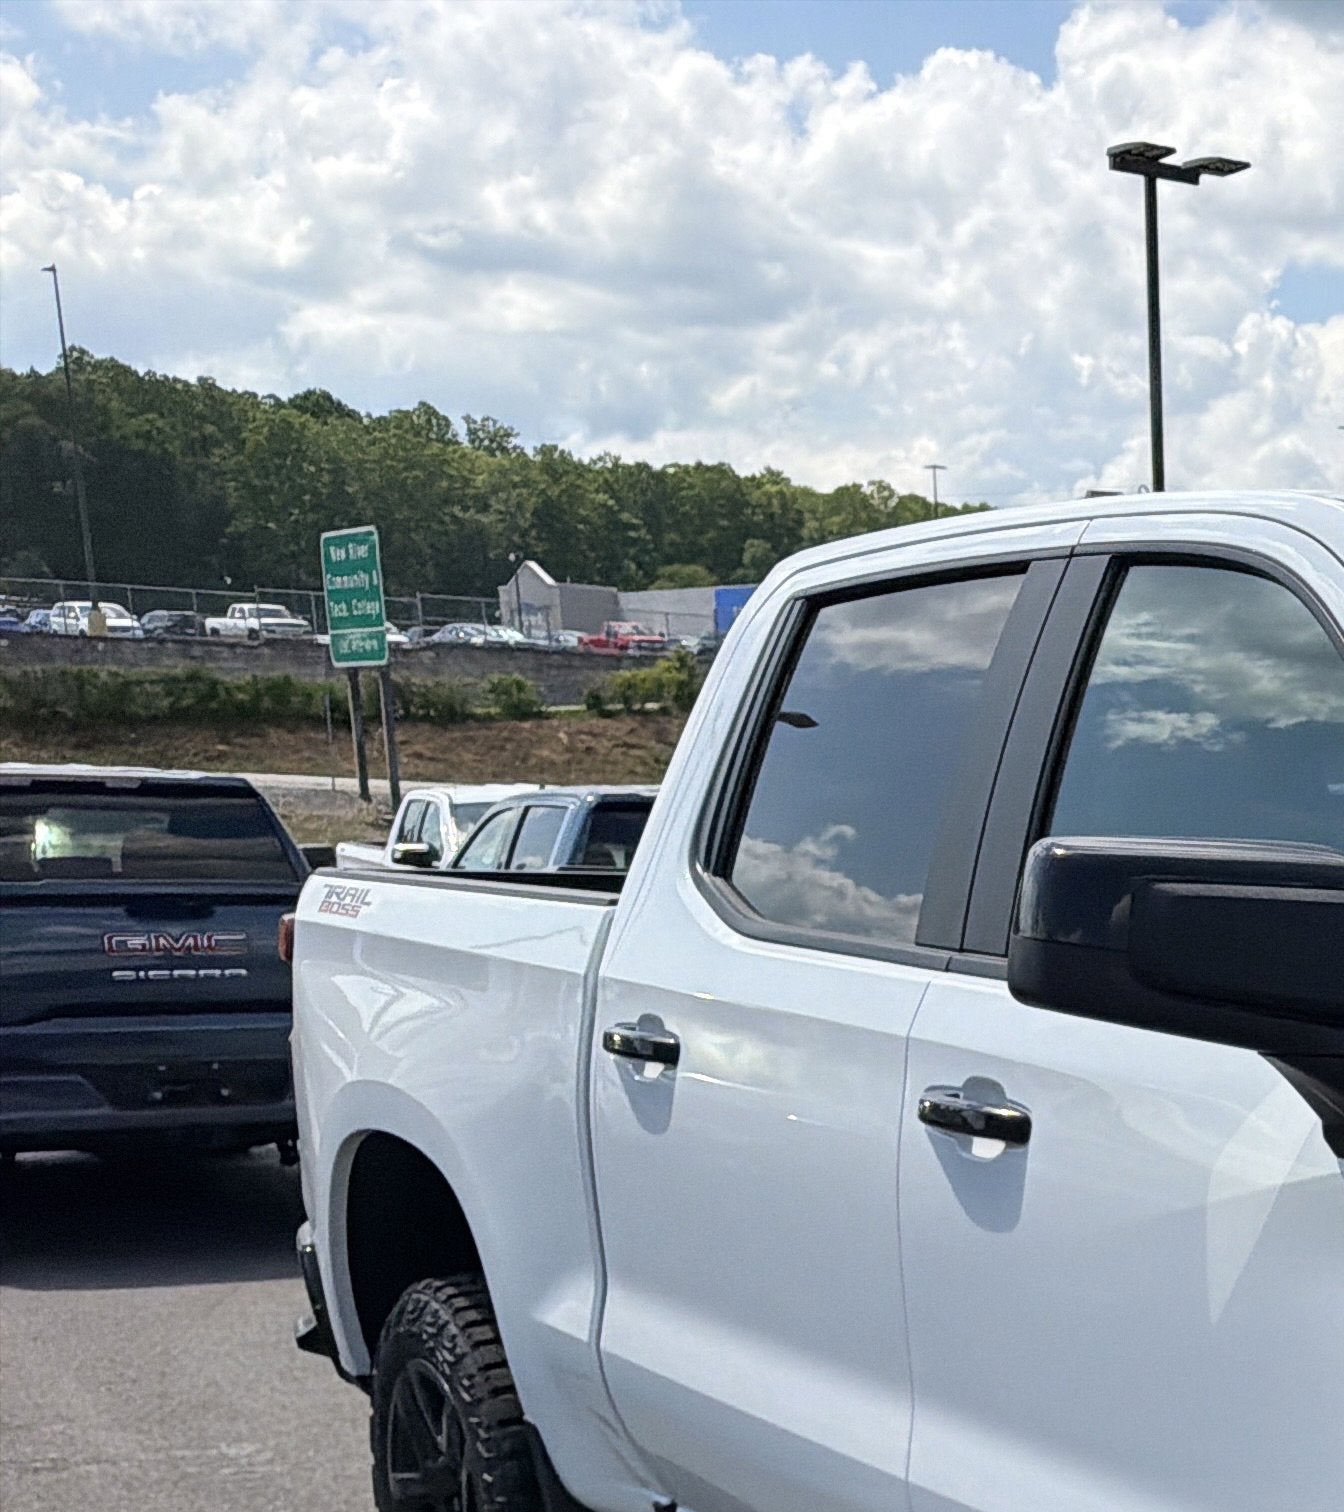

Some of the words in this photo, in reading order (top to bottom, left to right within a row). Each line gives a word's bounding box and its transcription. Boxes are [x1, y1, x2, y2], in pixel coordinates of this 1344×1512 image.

[326, 570, 370, 592] Community
[323, 883, 372, 906] TRAIL
[317, 900, 362, 919] BOSS
[103, 931, 248, 957] GMC
